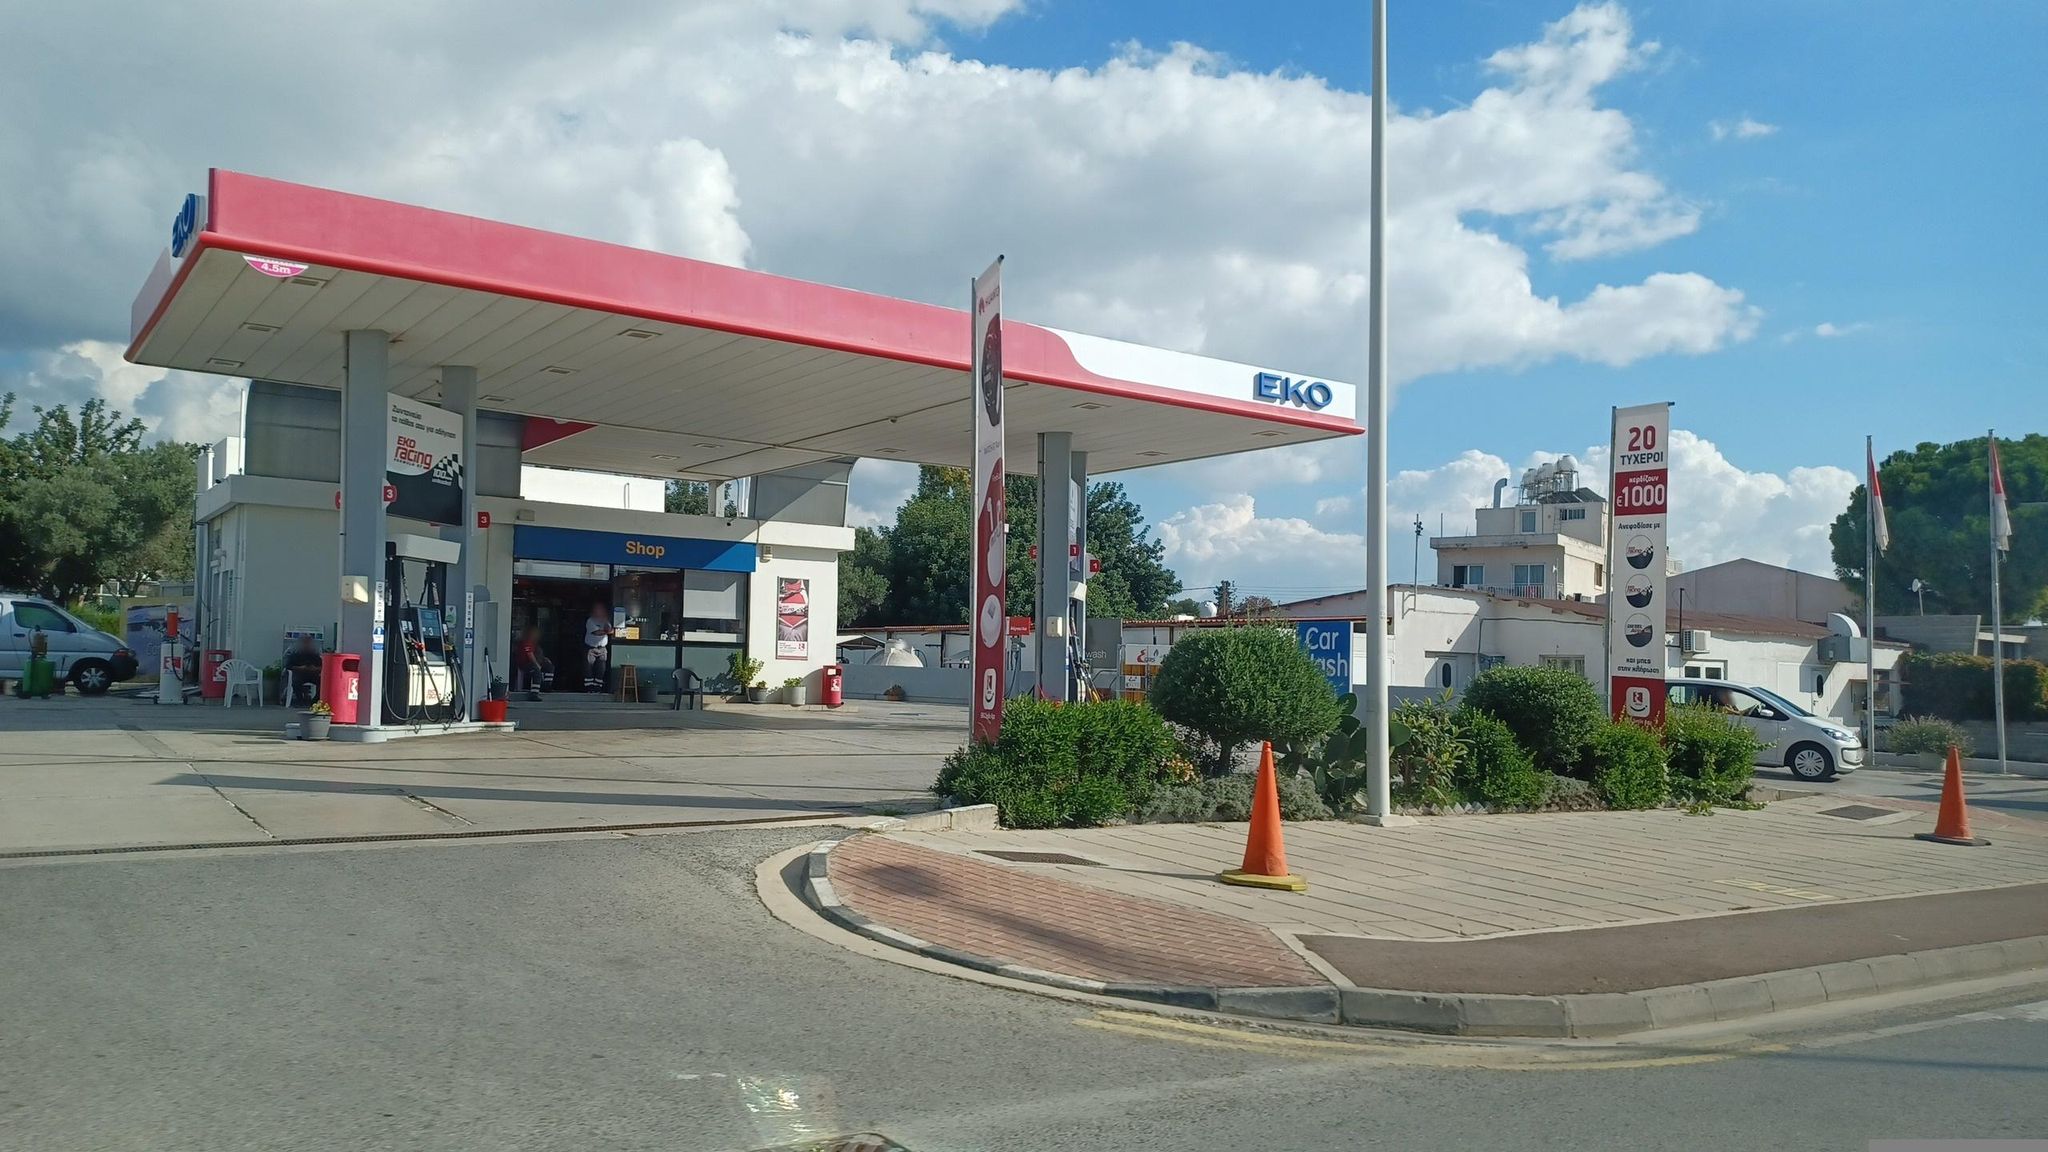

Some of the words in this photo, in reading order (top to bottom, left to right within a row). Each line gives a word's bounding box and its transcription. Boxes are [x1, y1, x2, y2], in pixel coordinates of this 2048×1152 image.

[261, 263, 291, 275] 4.5m
[1256, 371, 1333, 409] EKO
[397, 435, 416, 449] EKO
[1627, 425, 1656, 452] 20
[395, 446, 433, 470] racing
[1620, 452, 1664, 466] ΤΥΧΕΡΟΙ
[432, 468, 447, 479] 100
[386, 487, 394, 499] 3
[1616, 484, 1665, 508] €1000
[481, 515, 488, 525] 3
[625, 541, 665, 560] Shop
[1305, 627, 1340, 650] Car
[1085, 650, 1107, 659] wash
